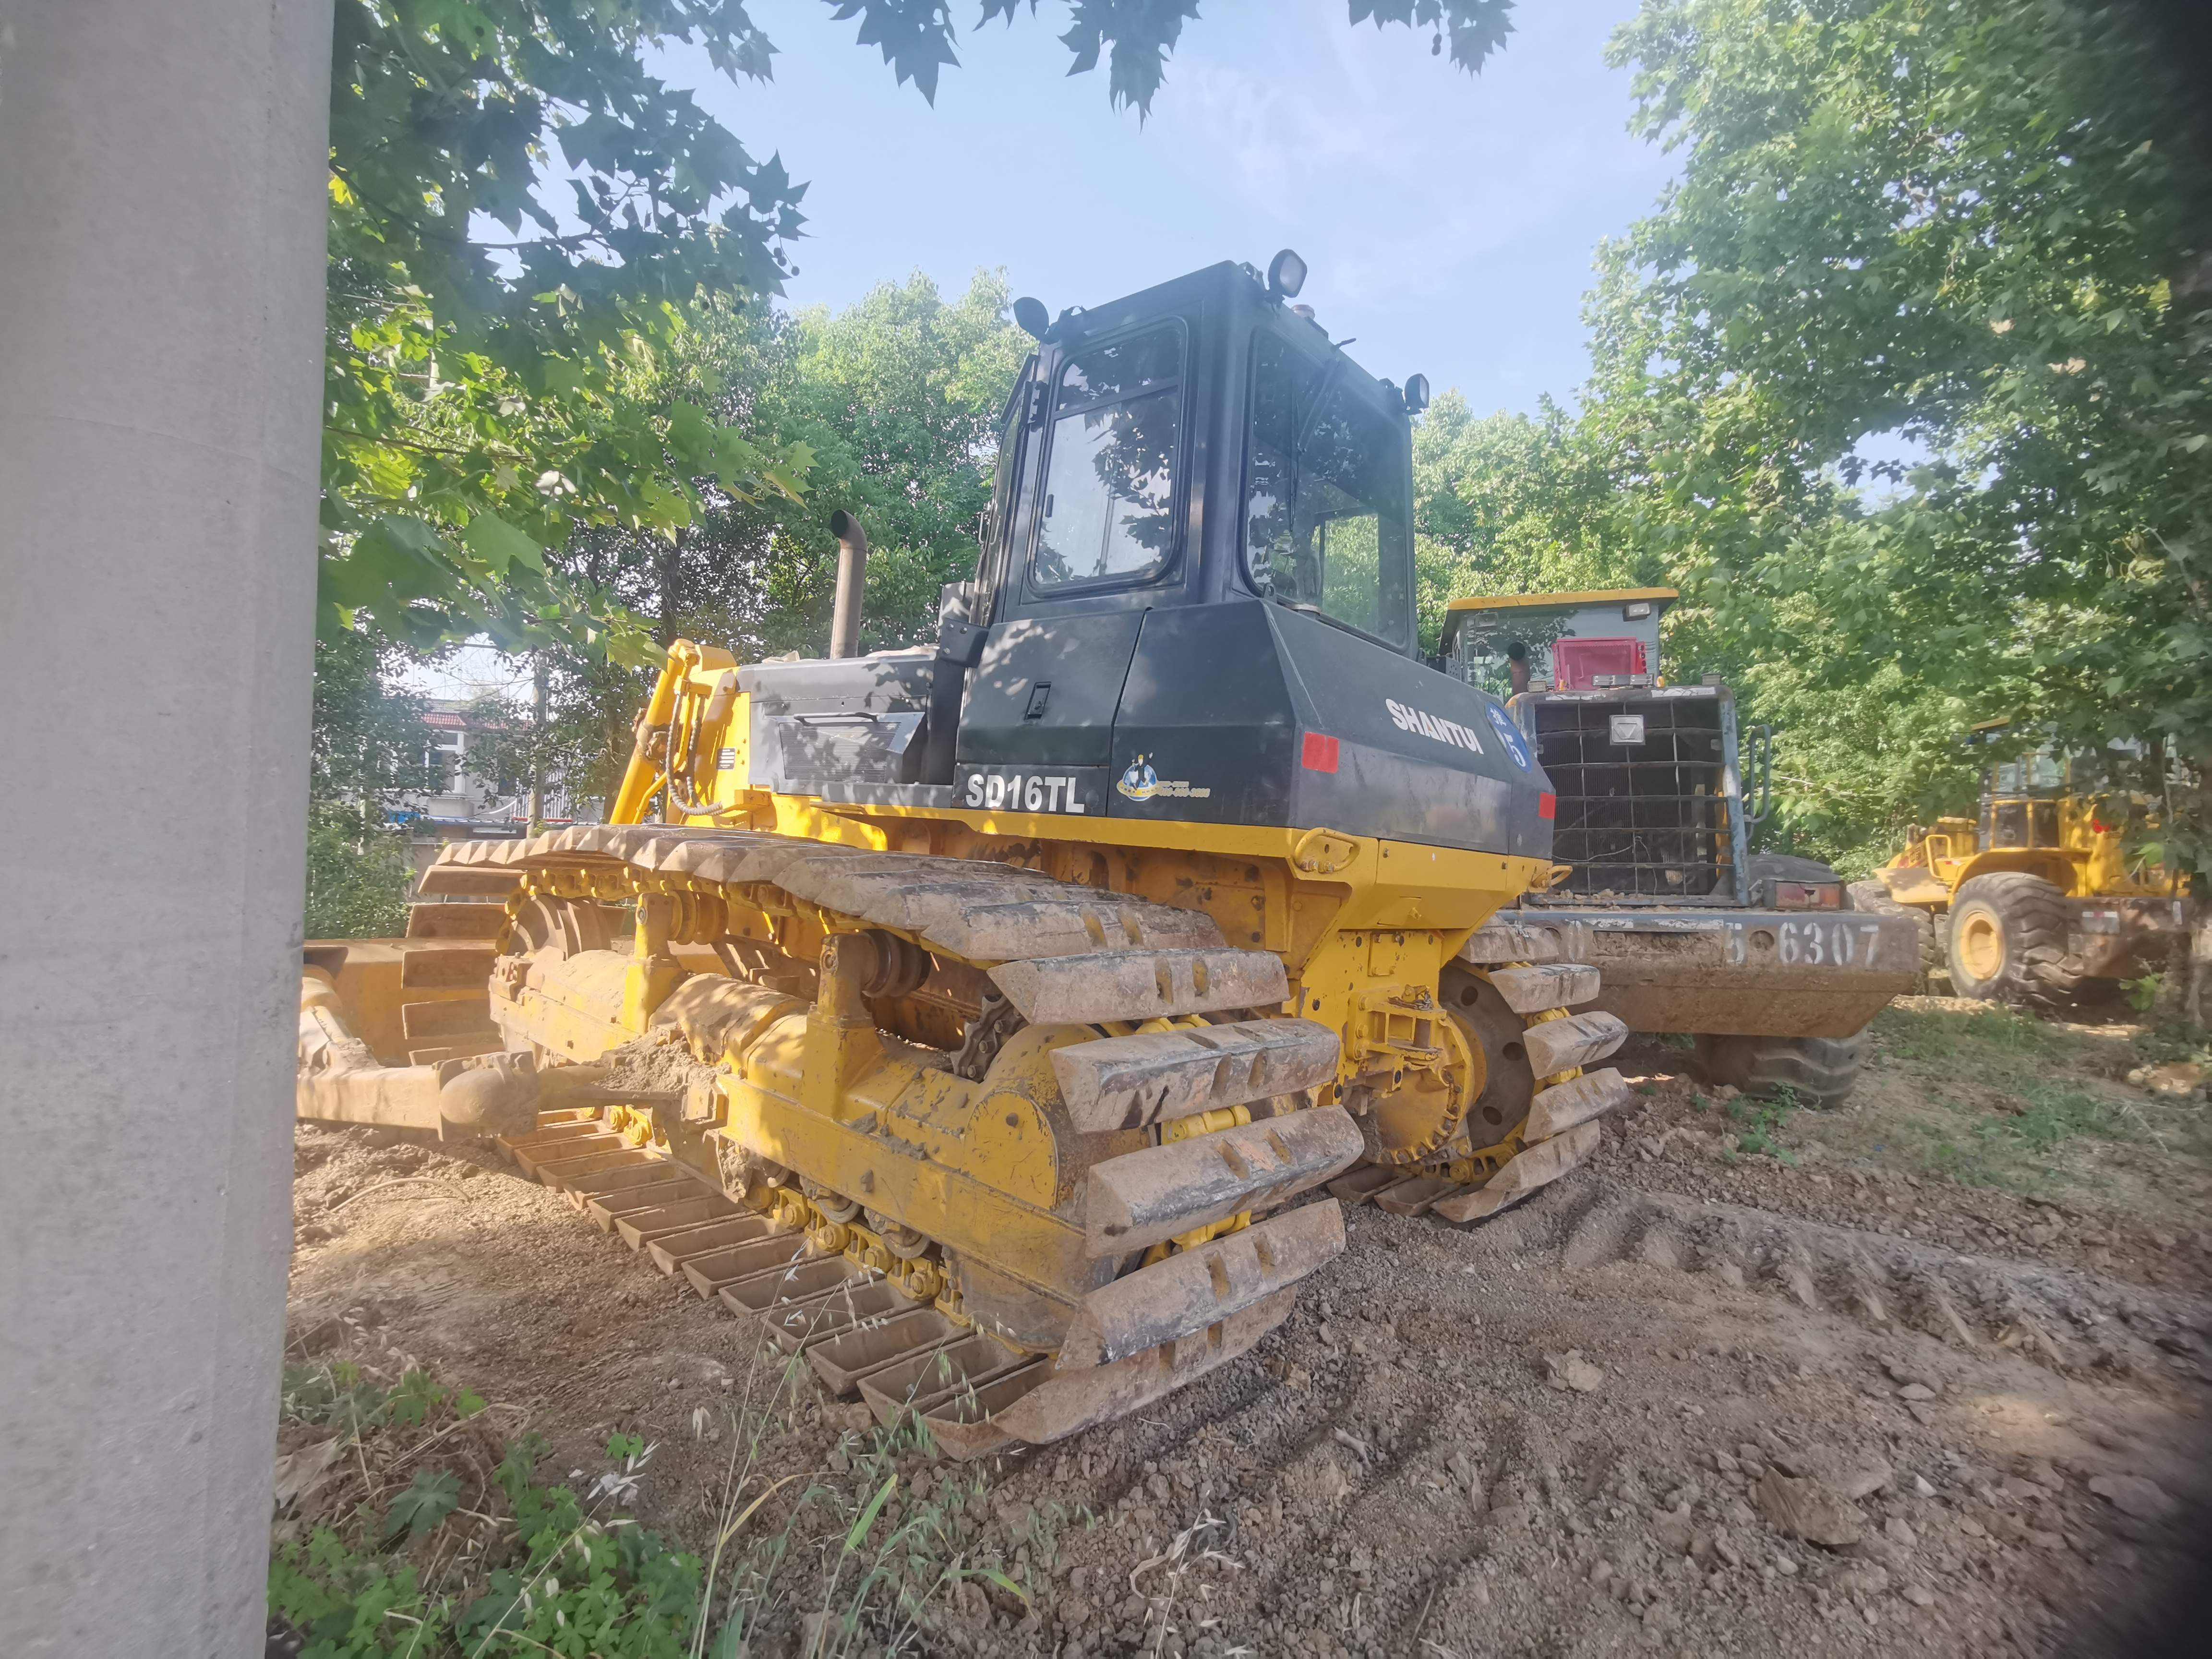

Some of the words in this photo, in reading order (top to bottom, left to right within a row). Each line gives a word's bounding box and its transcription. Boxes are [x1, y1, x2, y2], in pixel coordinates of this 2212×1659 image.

[1385, 698, 1485, 755] SHANTUI
[1503, 733, 1526, 767] 5
[965, 773, 1085, 813] SD16TL
[1779, 921, 1879, 967] 6307
